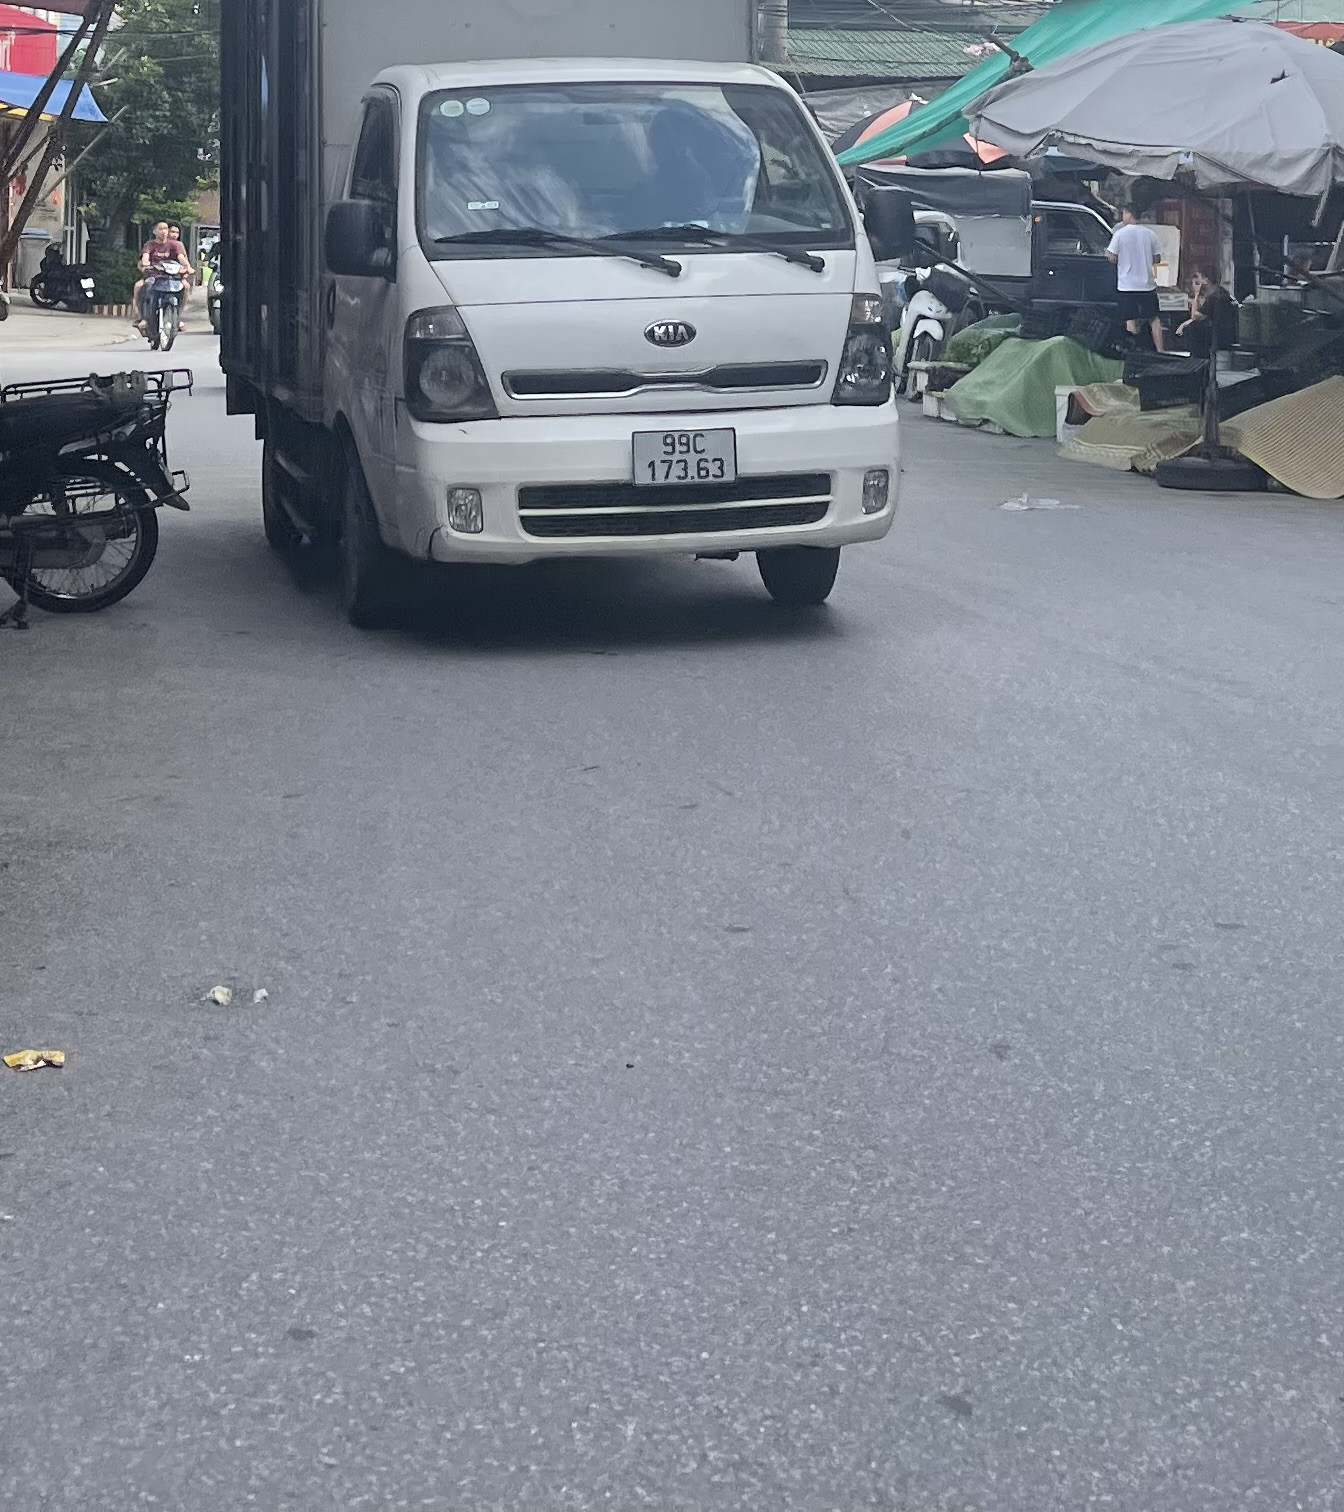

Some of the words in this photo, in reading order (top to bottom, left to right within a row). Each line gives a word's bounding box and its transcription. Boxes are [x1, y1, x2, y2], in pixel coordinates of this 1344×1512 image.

[654, 325, 689, 340] KIA
[662, 433, 706, 455] 99C
[648, 458, 725, 481] 173.63
